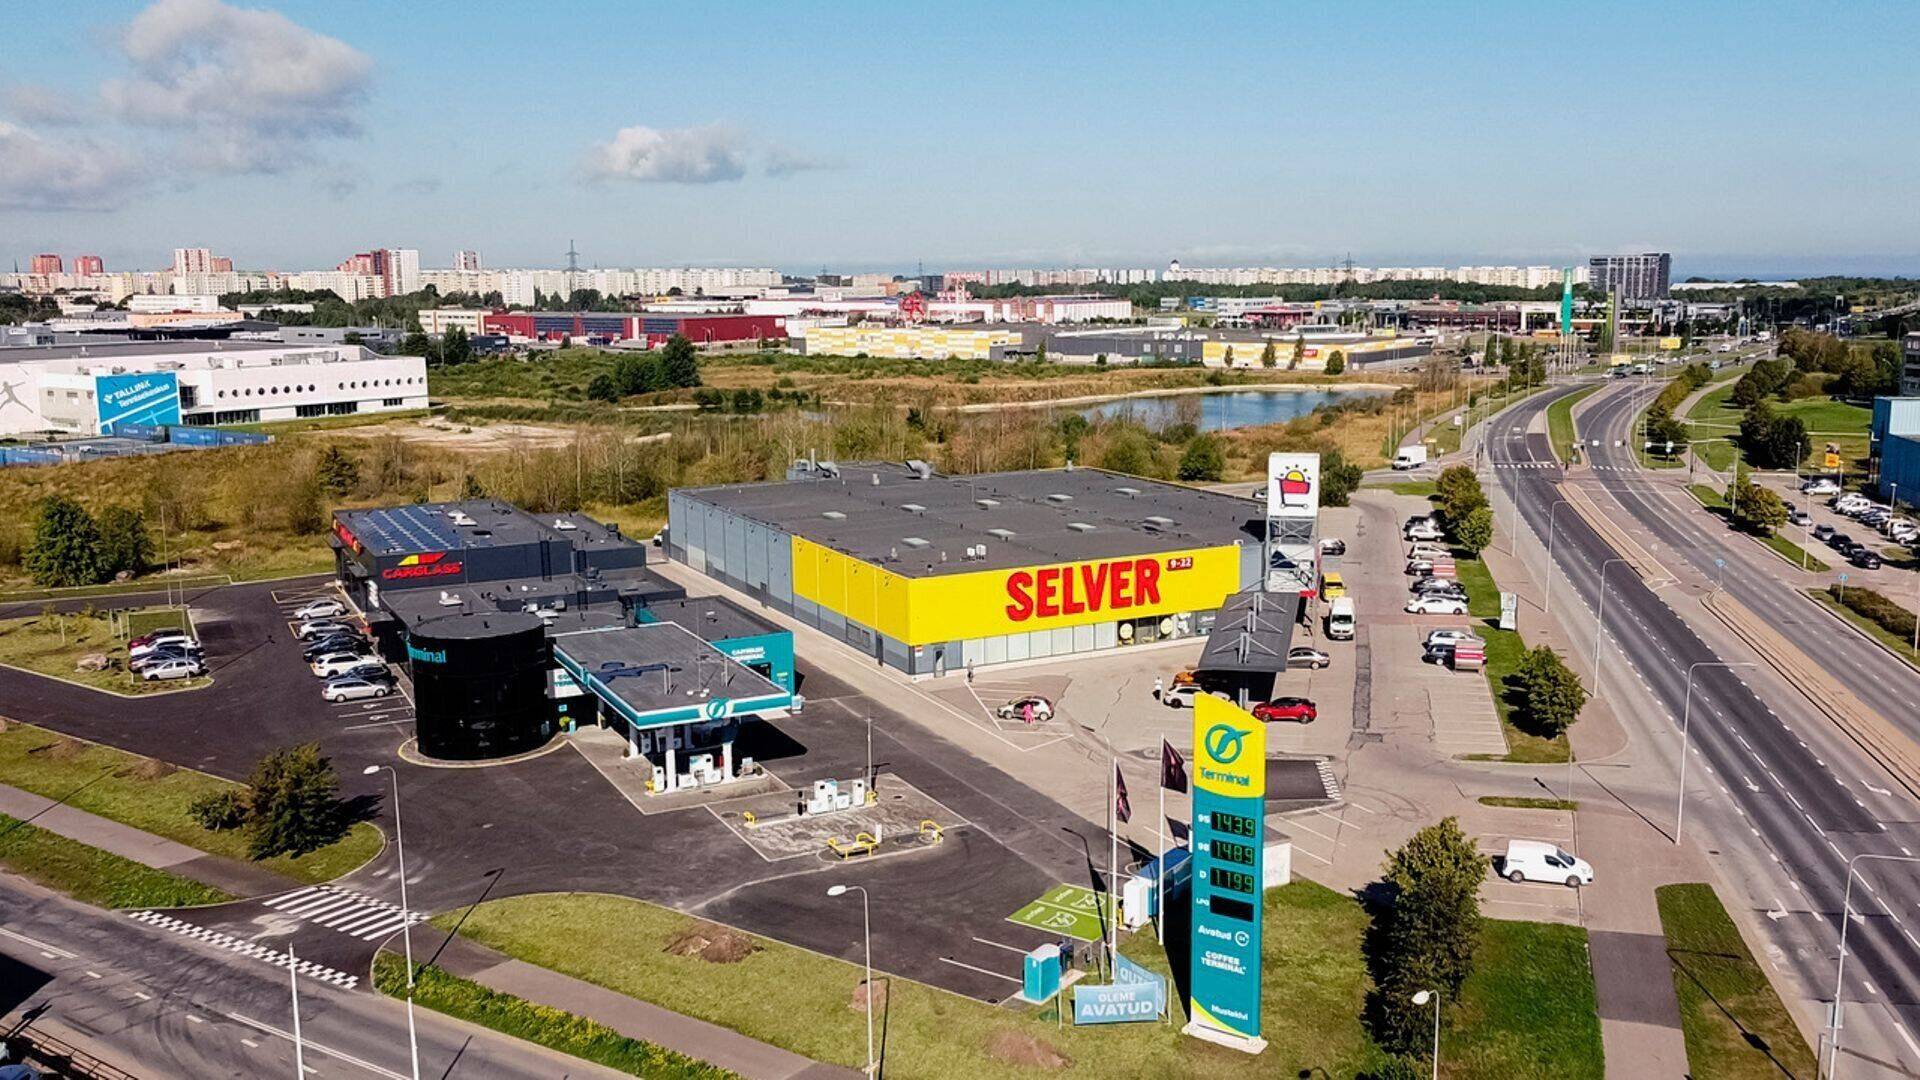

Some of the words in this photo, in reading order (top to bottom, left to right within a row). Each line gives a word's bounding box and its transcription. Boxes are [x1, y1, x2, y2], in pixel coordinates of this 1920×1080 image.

[113, 380, 151, 399] TALLINK
[383, 563, 462, 579] CARGLASS
[1006, 559, 1160, 621] SELVER
[1200, 766, 1250, 786] Terminal
[1198, 925, 1232, 940] Avatud
[1205, 951, 1240, 964] COFFEE
[1081, 1001, 1153, 1016] AVATUD
